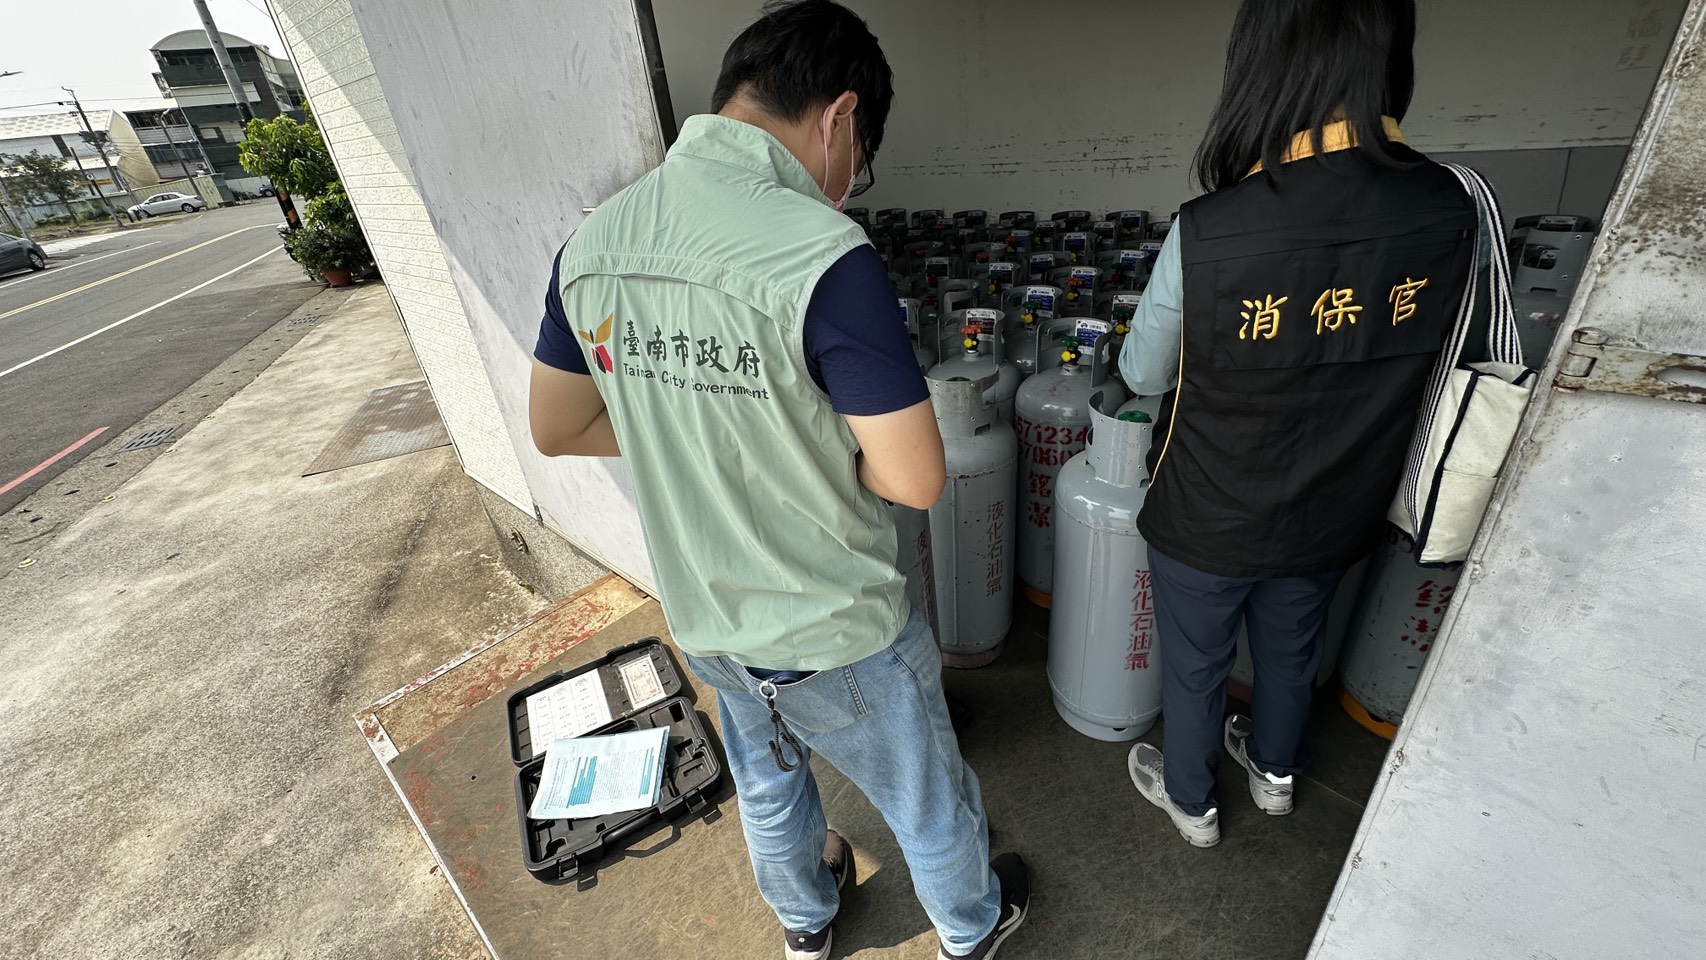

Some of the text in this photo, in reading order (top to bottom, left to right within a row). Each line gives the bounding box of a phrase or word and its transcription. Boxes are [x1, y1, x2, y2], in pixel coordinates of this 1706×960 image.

[1239, 277, 1429, 340] 消保官
[623, 320, 761, 379] 臺南市政府
[661, 370, 686, 389] City
[987, 500, 1004, 597] 液化石油氣
[1124, 569, 1154, 671] 液化石油氣
